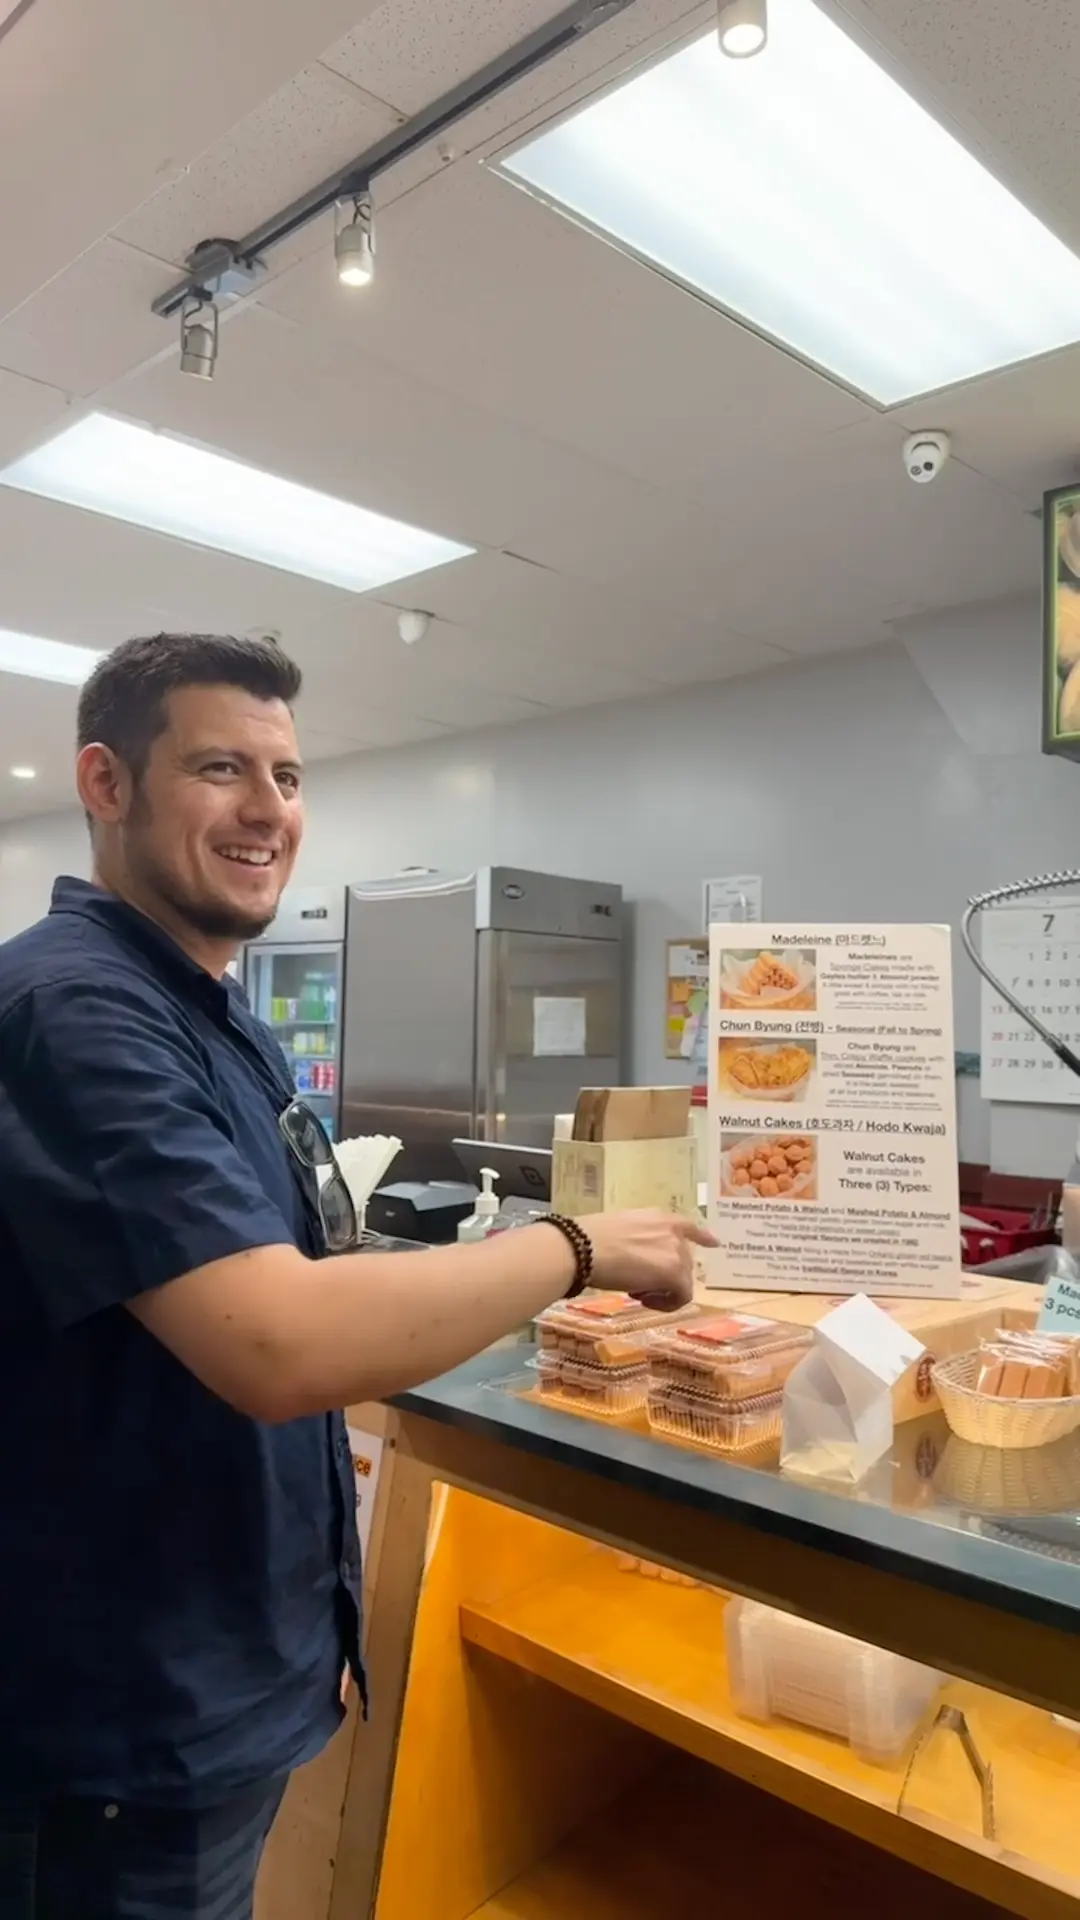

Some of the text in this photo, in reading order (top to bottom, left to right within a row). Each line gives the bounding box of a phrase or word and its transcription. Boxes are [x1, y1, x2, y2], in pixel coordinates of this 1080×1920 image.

[1042, 914, 1055, 932] 7
[771, 934, 832, 945] Madeleine
[720, 1019, 751, 1031] Chun
[755, 1020, 792, 1033] Byung
[836, 1024, 876, 1034] Seasonal
[898, 1026, 908, 1034] to
[910, 1026, 943, 1036] Spring)
[847, 1042, 871, 1050] Chun
[873, 1042, 901, 1052] Byung
[719, 1116, 760, 1127] Walnut
[764, 1116, 802, 1129] Cakes
[866, 1120, 899, 1132] Hodo
[903, 1121, 946, 1136] Kwaja)
[843, 1150, 926, 1164] Walnut Cakes
[847, 1166, 922, 1177] are available in
[838, 1178, 932, 1193] Three (3) Types:
[732, 1202, 763, 1211] Mashed
[765, 1203, 792, 1212] Potato
[802, 1206, 829, 1214] Walnut
[848, 1208, 880, 1217] Mashed
[881, 1209, 909, 1218] Potato
[919, 1211, 951, 1220] Almond
[728, 1242, 744, 1250] Red
[746, 1243, 766, 1251] Bean
[1044, 1297, 1055, 1310] 3
